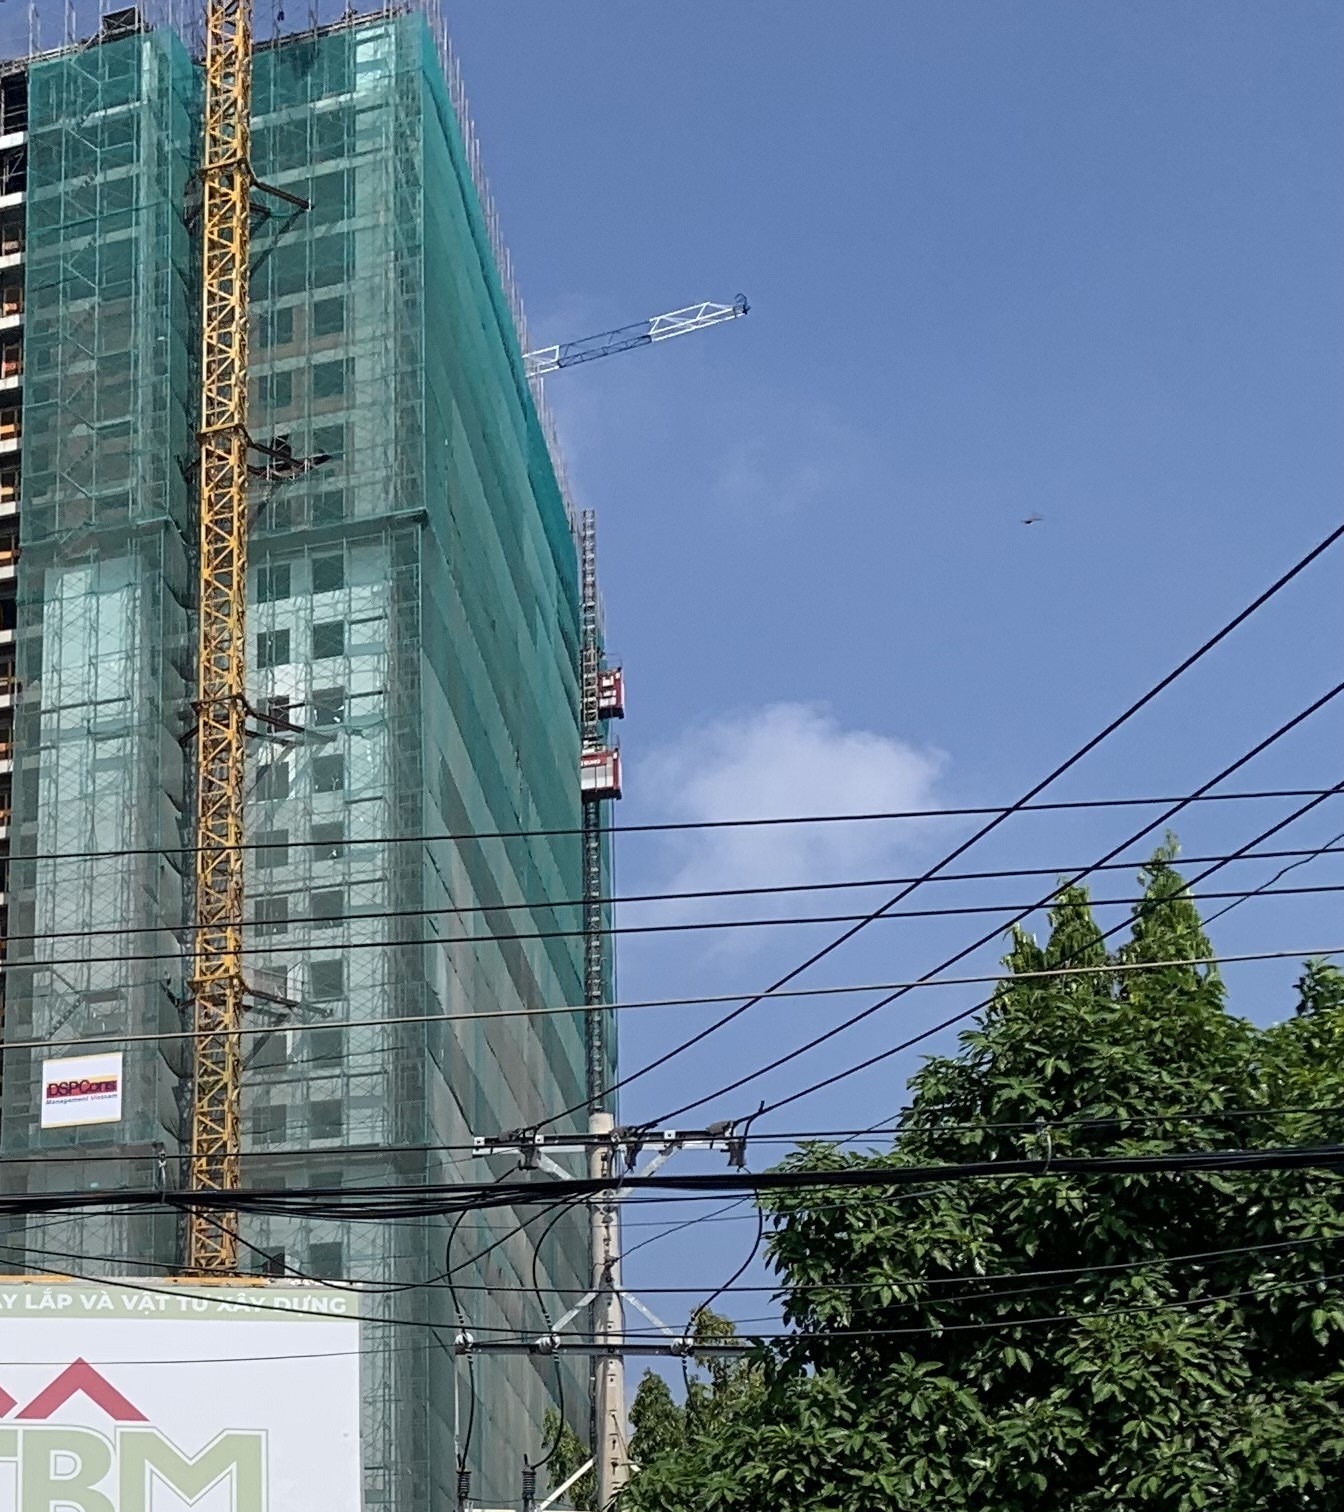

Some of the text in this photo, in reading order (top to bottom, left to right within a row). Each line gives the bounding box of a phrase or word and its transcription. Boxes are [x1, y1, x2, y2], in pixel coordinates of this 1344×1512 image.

[24, 1289, 73, 1313] LẮP
[78, 1290, 116, 1312] VÀ
[122, 1290, 171, 1319] VẬT
